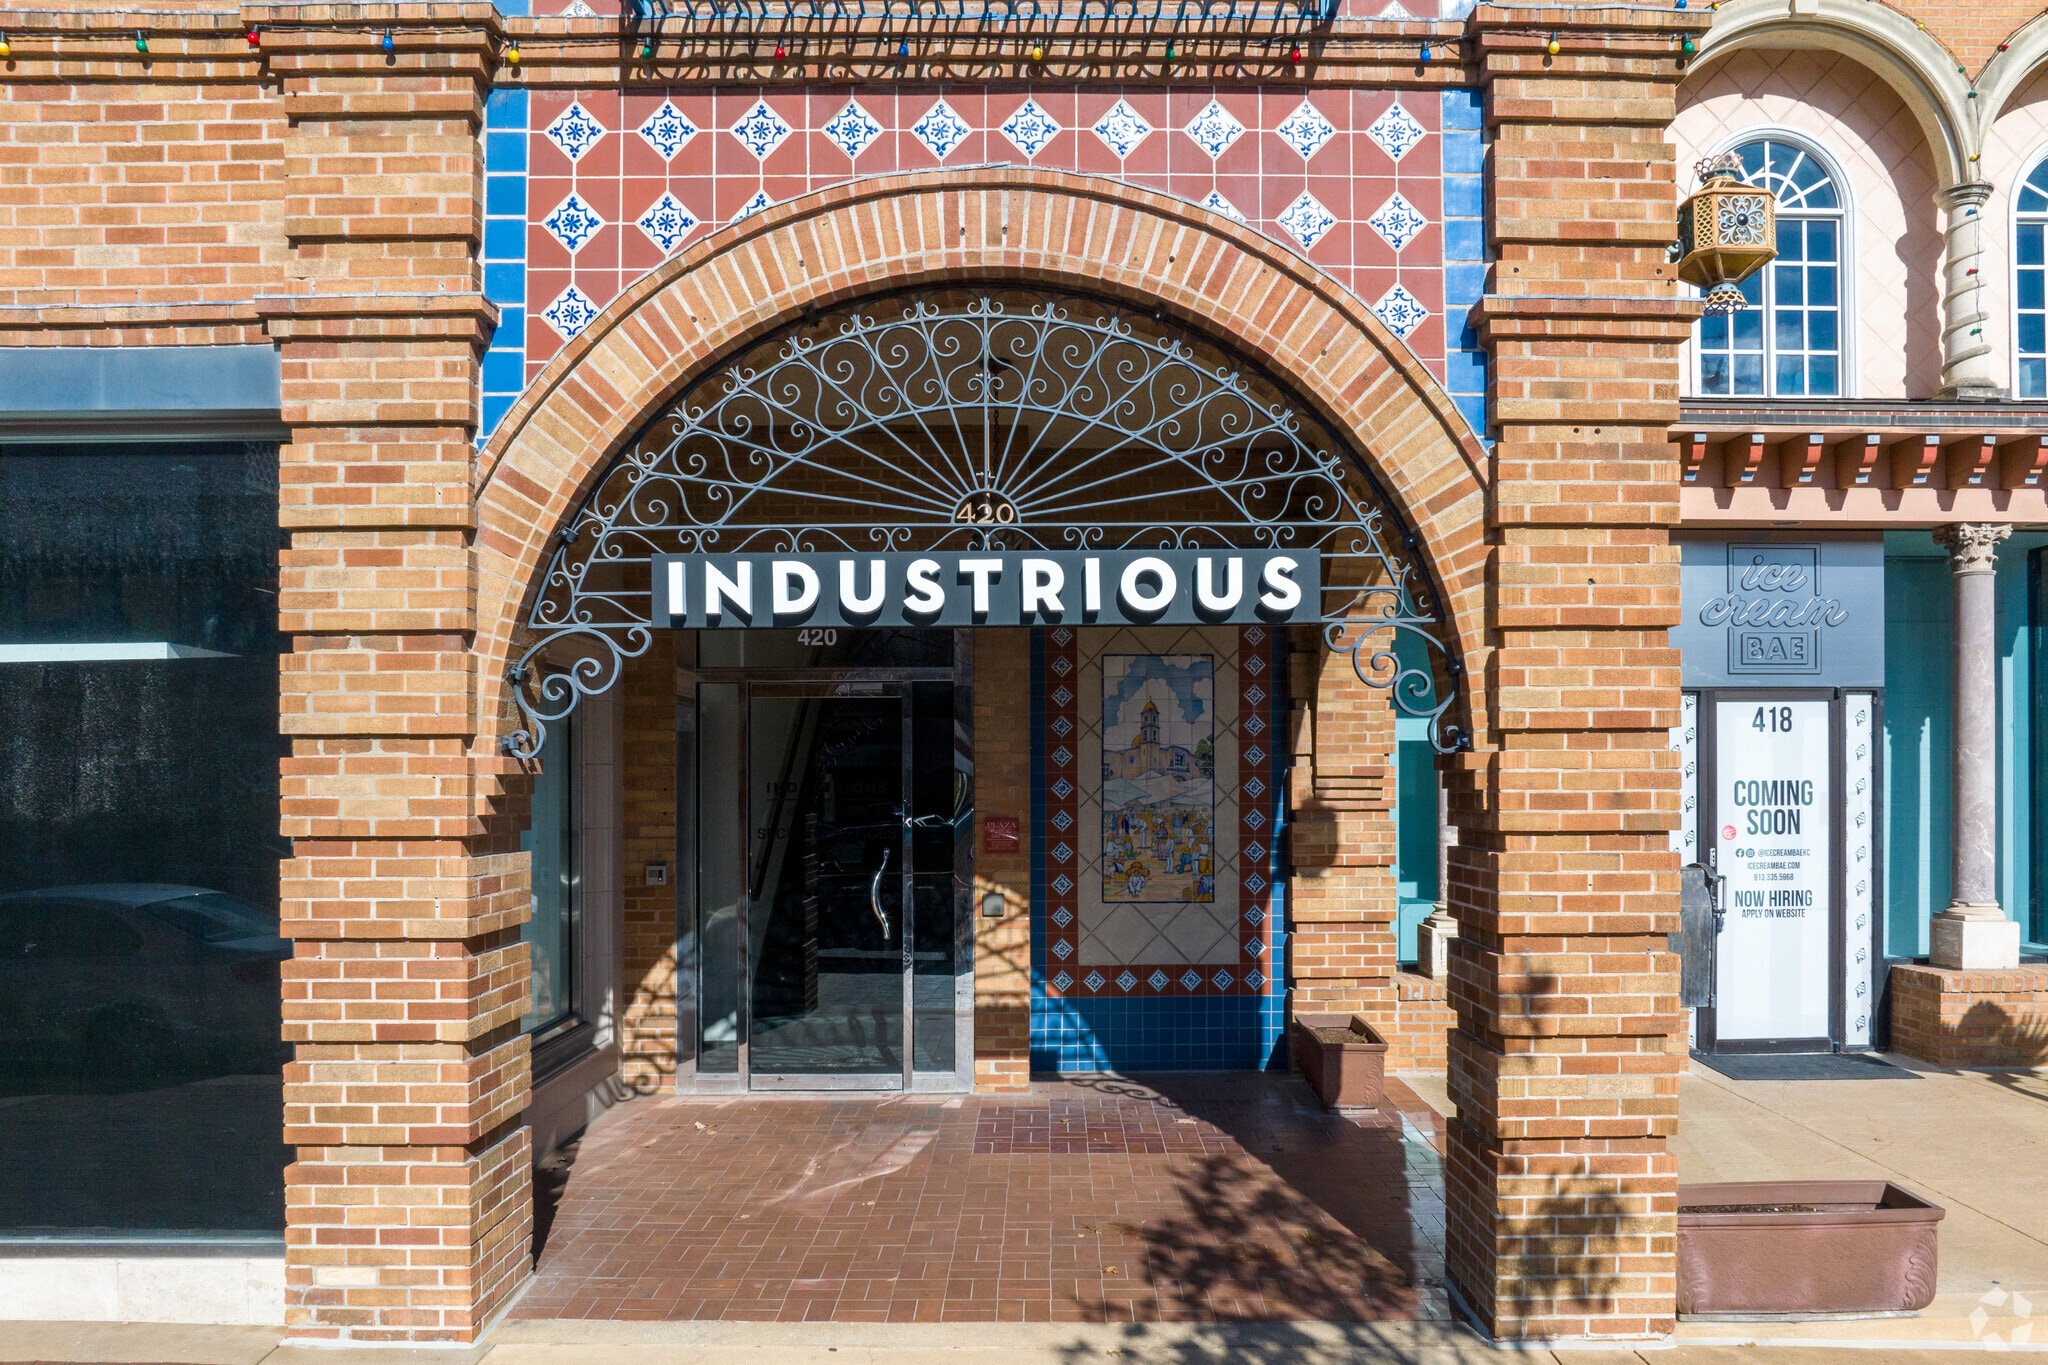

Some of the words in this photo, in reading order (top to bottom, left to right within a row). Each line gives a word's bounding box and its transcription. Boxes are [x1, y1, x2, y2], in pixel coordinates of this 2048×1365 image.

[956, 502, 1014, 524] 420
[1741, 554, 1808, 592] ice
[667, 556, 1303, 616] INDUSTRIOUS
[1699, 594, 1849, 628] cream
[797, 628, 837, 646] 420
[1746, 637, 1804, 660] BAE
[1752, 706, 1792, 732] 418
[1734, 780, 1813, 806] COMING
[1747, 809, 1800, 835] SOON
[1747, 861, 1801, 870] ICECREAMBAE.COM
[1735, 890, 1765, 907] NOW
[1769, 889, 1813, 906] HIRING
[1741, 909, 1763, 918] APPLY
[1764, 909, 1774, 917] ON
[1775, 908, 1806, 917] WEBSITE
